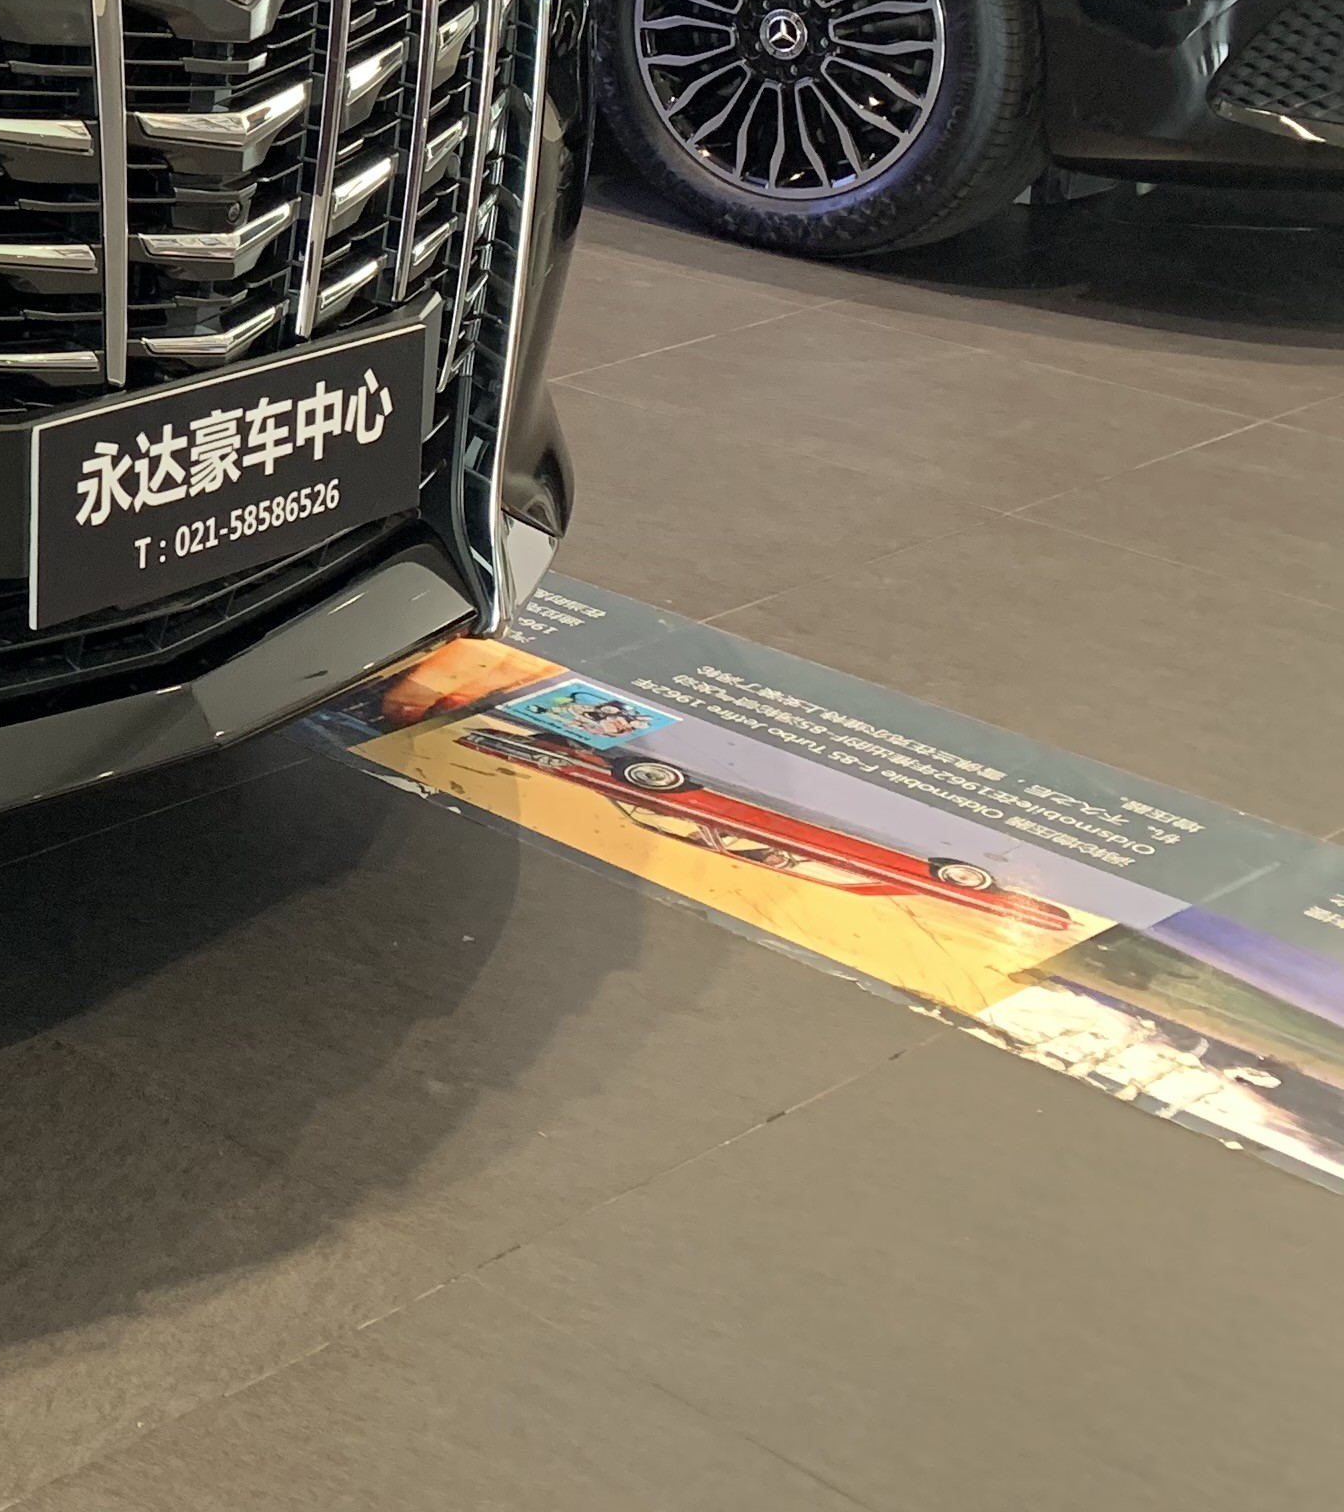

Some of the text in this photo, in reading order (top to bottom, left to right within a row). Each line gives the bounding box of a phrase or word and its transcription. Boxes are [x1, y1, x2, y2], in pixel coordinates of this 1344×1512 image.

[75, 368, 394, 527] 永达豪车中心
[768, 727, 827, 755] Turbo
[827, 750, 880, 774] F-85
[880, 767, 1004, 820] Oldsmobile
